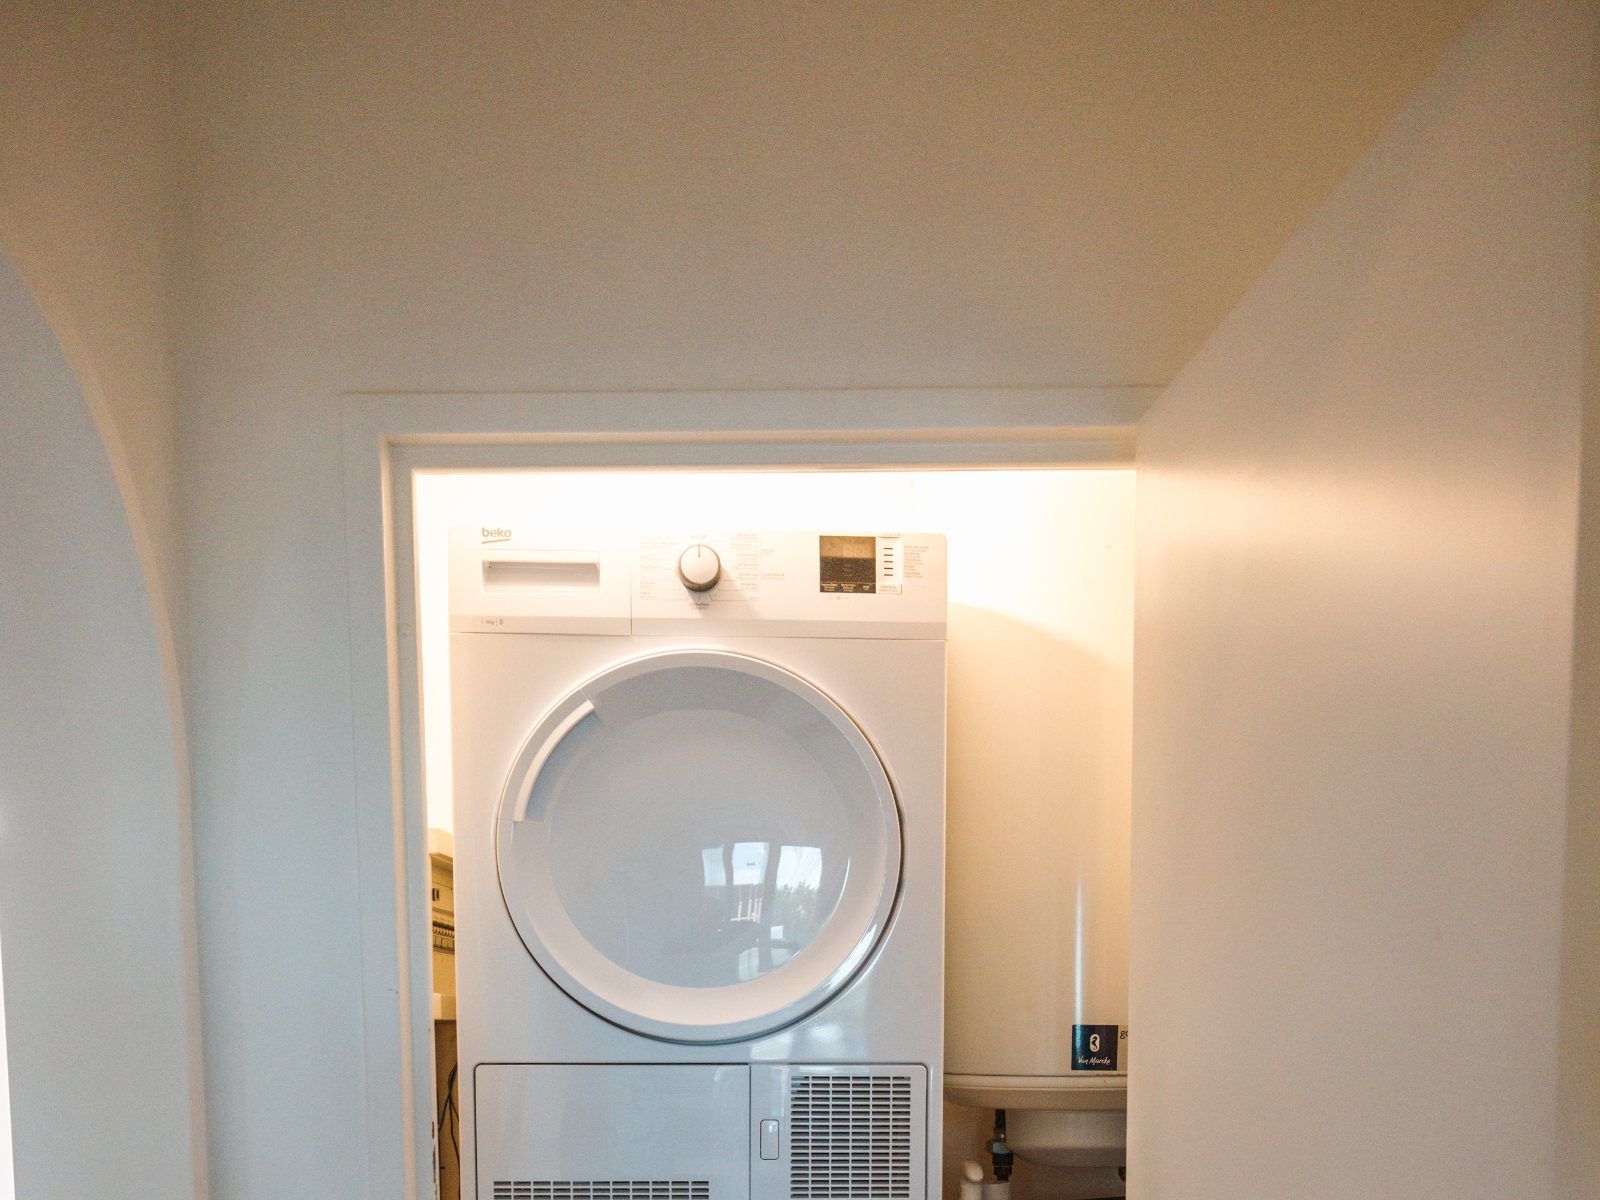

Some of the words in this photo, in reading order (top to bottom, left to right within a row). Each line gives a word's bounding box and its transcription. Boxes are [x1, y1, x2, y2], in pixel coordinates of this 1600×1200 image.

[481, 527, 512, 538] beko
[1078, 1056, 1088, 1065] Van
[1089, 1056, 1111, 1066] Marcke
